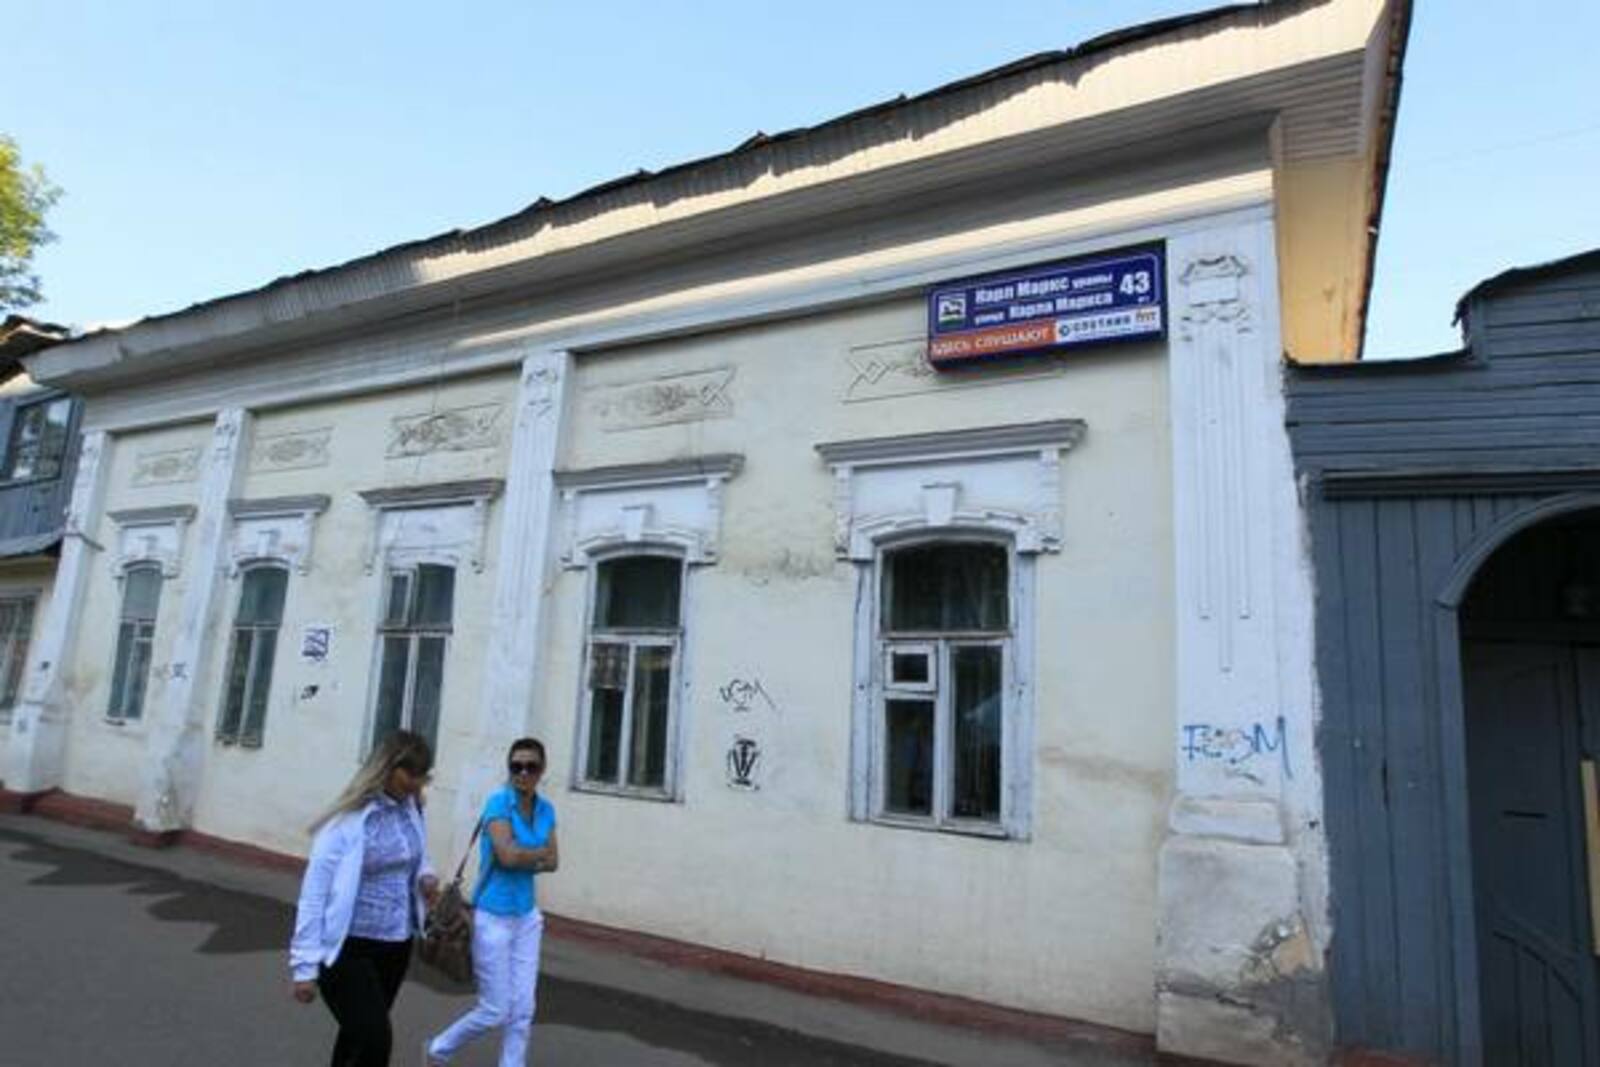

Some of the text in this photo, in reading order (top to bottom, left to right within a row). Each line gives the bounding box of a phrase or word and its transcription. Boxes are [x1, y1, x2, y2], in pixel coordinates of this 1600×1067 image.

[976, 285, 1014, 304] Карл
[1017, 277, 1069, 298] Маркс
[1119, 271, 1150, 295] 43
[1009, 301, 1053, 319] Карла
[1055, 292, 1113, 313] Маркса
[975, 326, 1050, 349] СЛУШАЮТ
